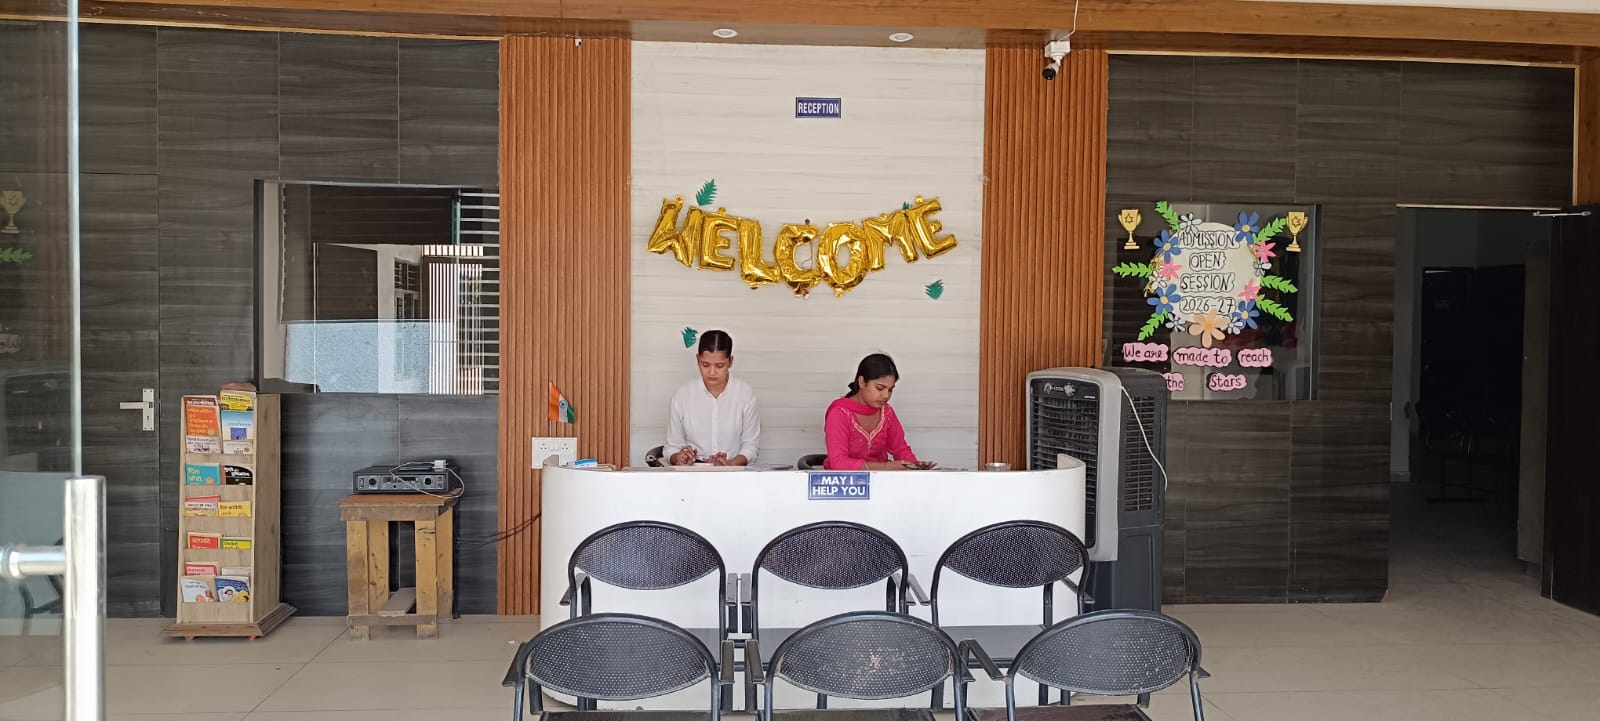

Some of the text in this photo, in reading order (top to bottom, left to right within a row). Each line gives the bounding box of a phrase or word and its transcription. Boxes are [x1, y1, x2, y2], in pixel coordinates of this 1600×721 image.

[798, 102, 839, 114] RECEPTION
[648, 196, 958, 294] WELCOME
[1180, 231, 1235, 248] ADMISSION
[1190, 253, 1220, 268] OPEN
[1181, 273, 1231, 291] SESSION
[1182, 298, 1234, 313] 2026-27
[1124, 346, 1269, 364] We are made to reach
[1166, 376, 1184, 389] the
[821, 476, 853, 485] MAY I
[812, 486, 866, 495] HELP YOU
